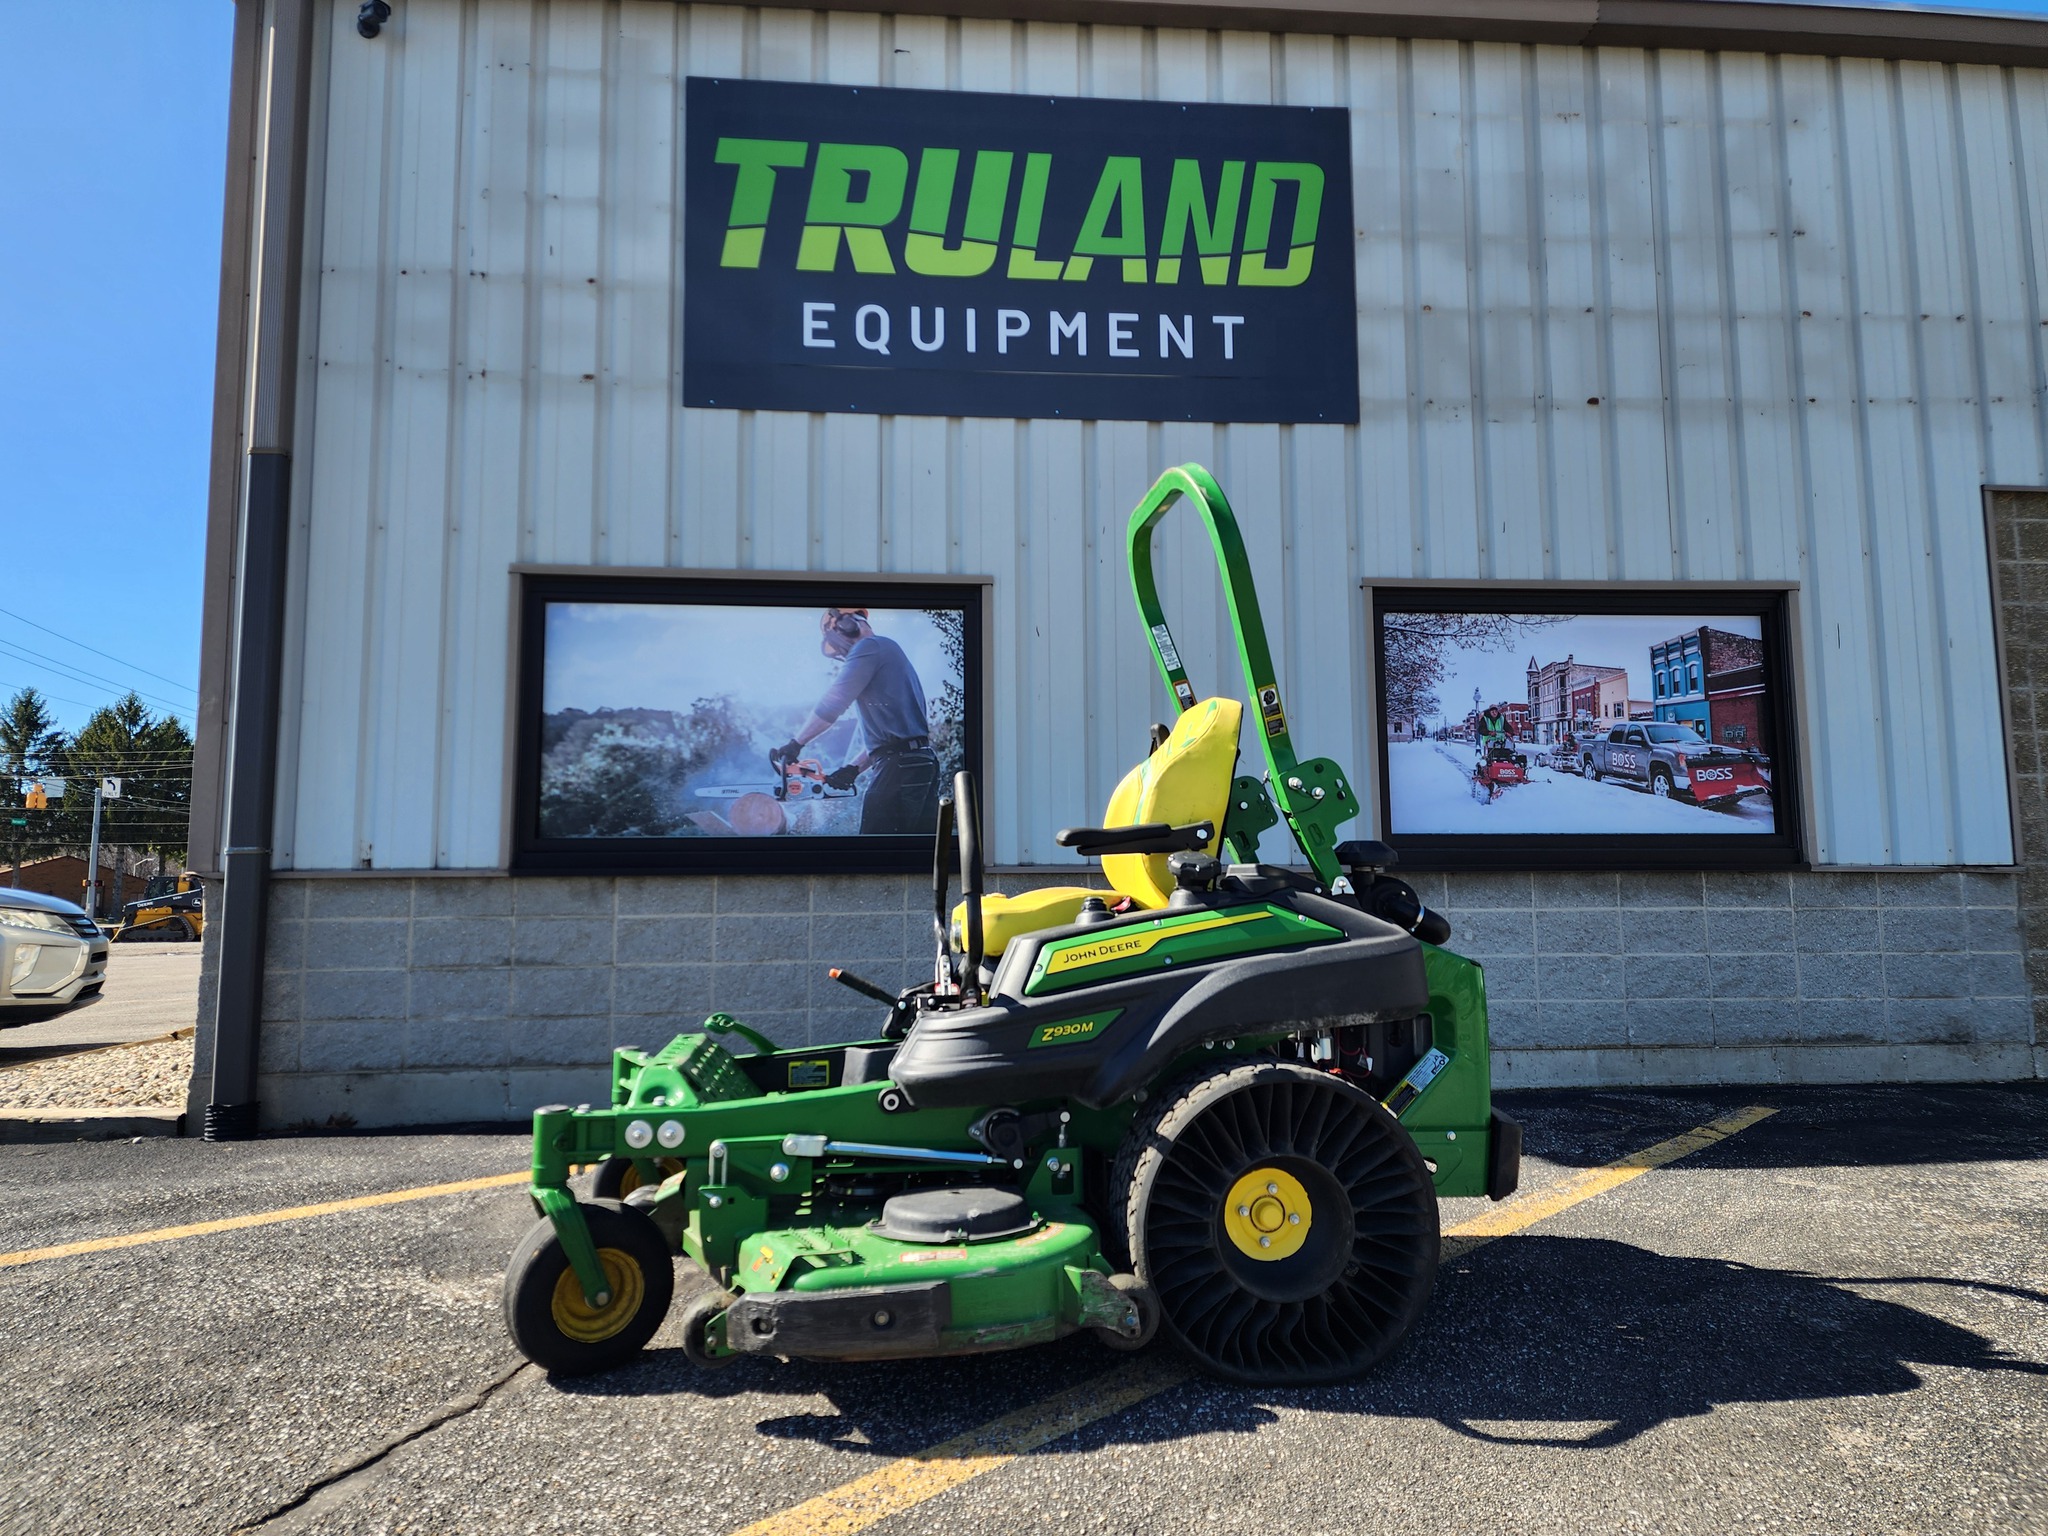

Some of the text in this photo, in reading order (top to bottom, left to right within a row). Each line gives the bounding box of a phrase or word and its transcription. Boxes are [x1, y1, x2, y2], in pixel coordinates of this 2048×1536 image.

[714, 137, 1325, 288] TRULAND
[801, 301, 1246, 360] EQUIPMENT
[1612, 752, 1636, 769] BOSS
[1696, 767, 1733, 782] BOSS
[1064, 940, 1141, 963] JOHN DEERE
[1041, 1021, 1094, 1042] Z930M
